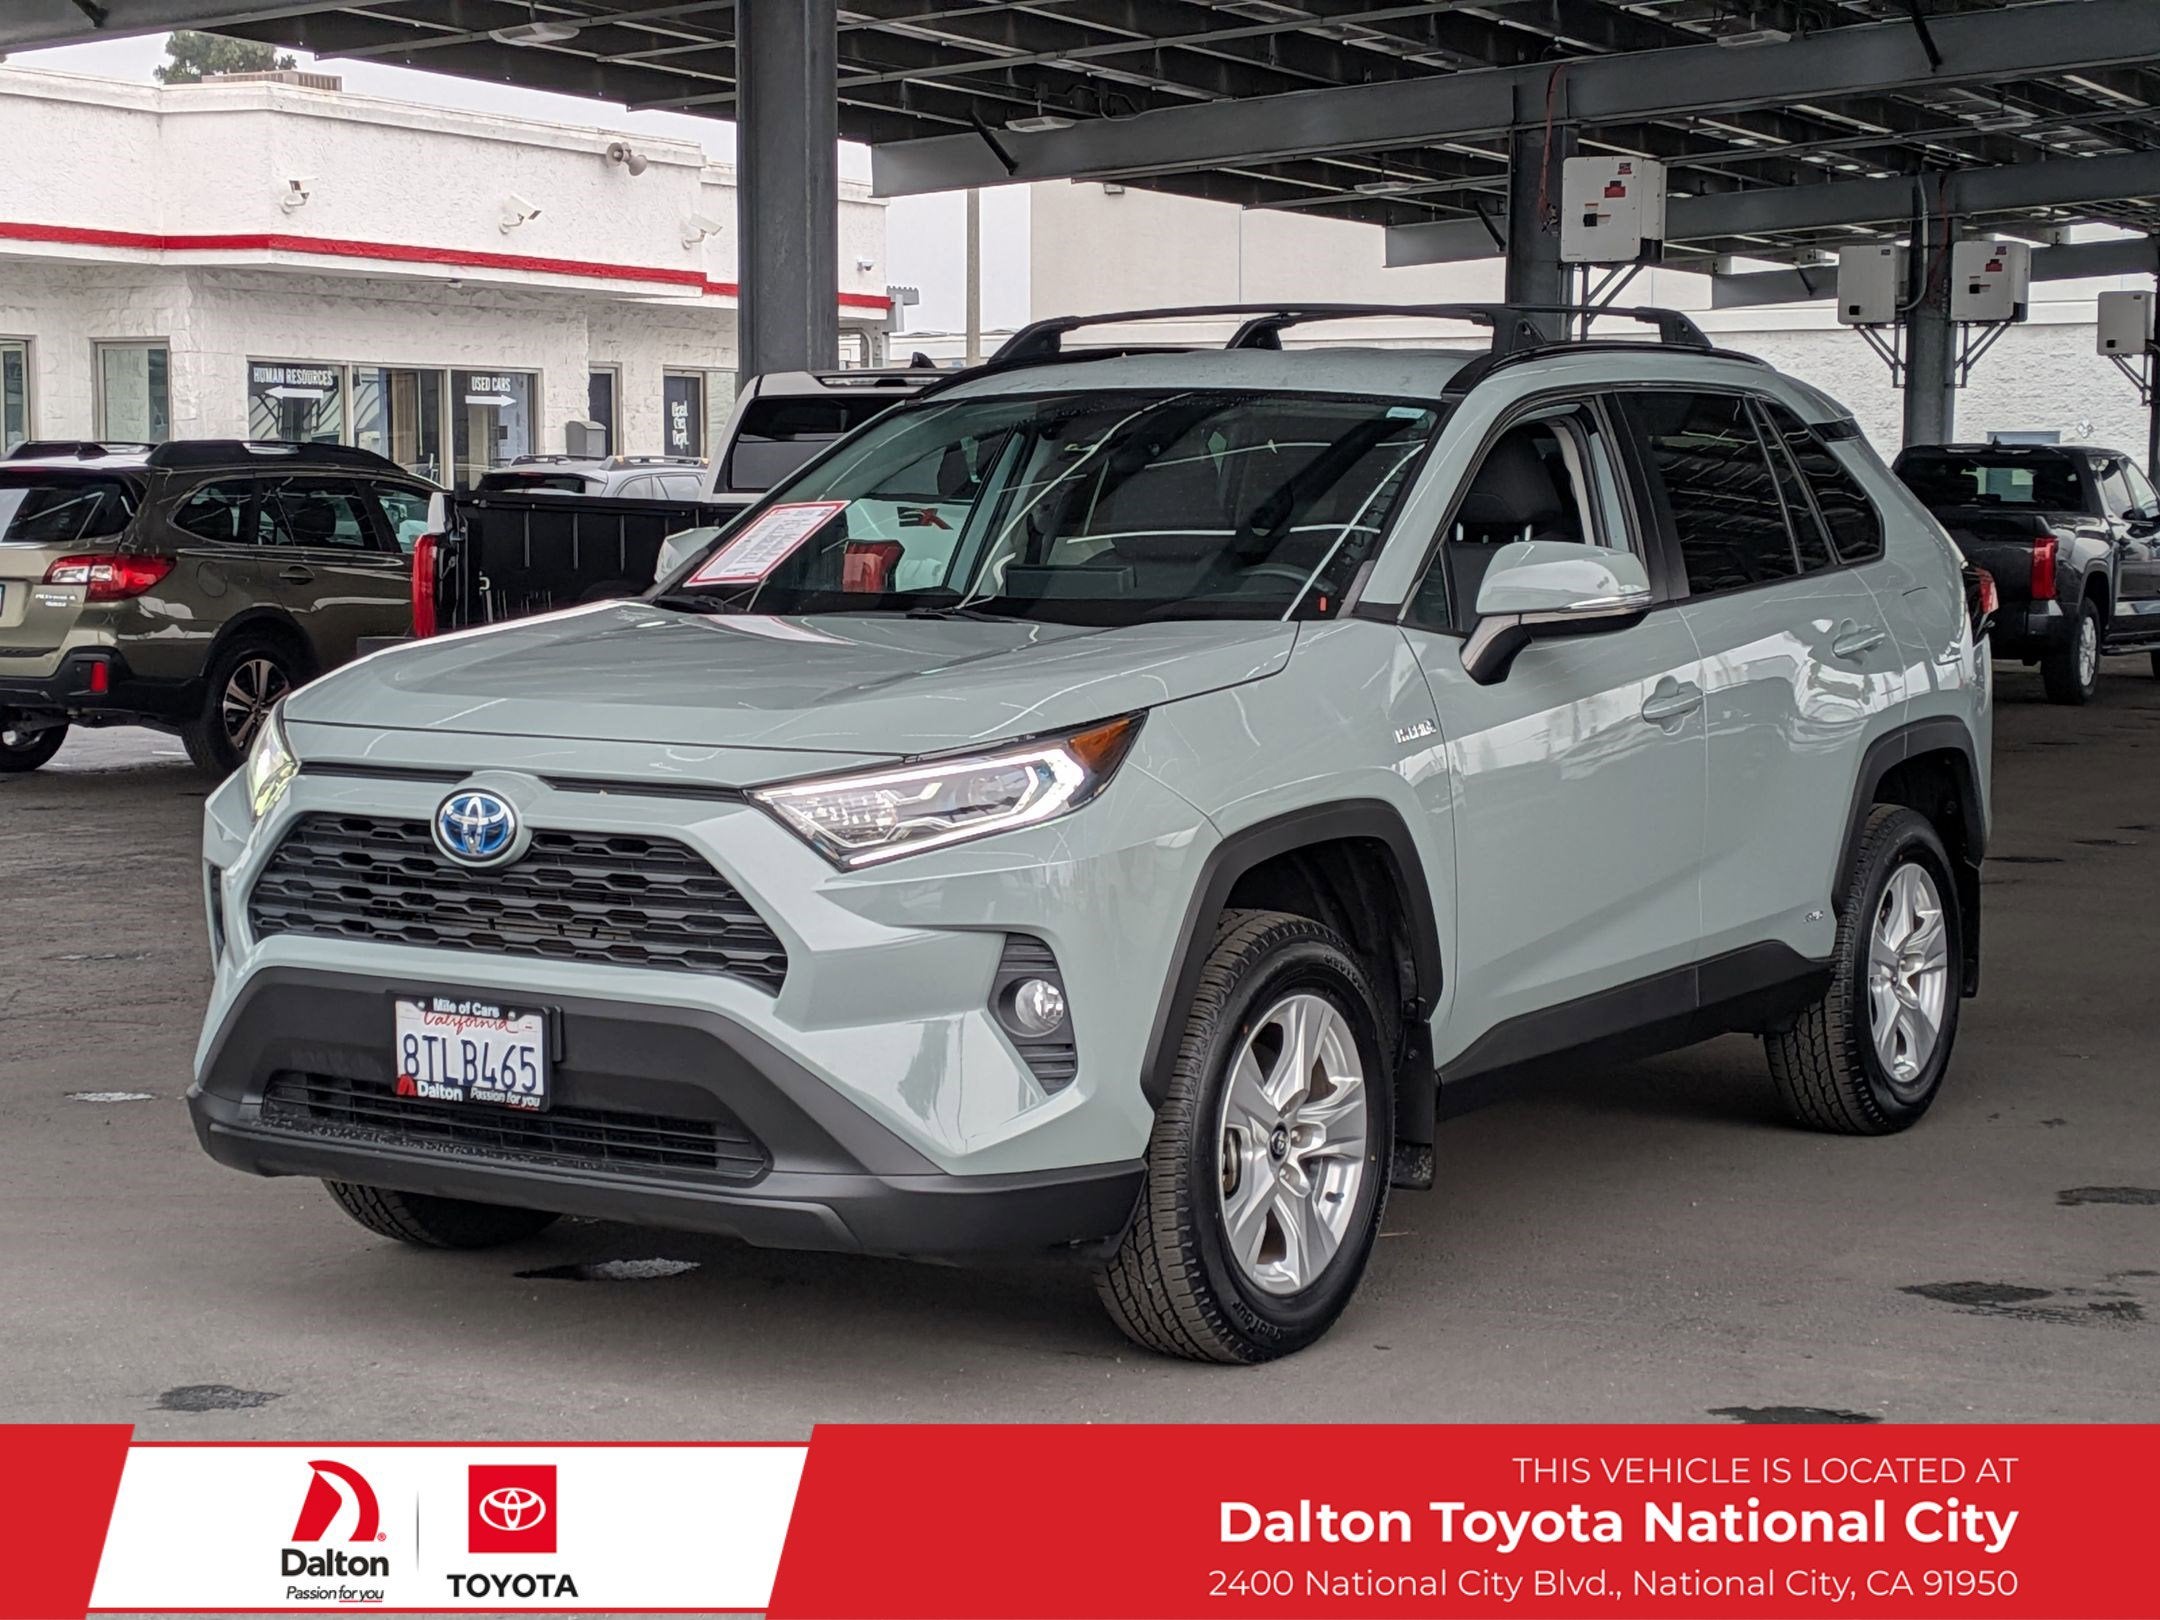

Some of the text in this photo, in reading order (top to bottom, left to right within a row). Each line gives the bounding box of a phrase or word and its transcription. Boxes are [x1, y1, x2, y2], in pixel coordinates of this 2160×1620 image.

[253, 367, 334, 386] HUMAN RESOURCES
[471, 375, 511, 392] USED CARS
[433, 997, 500, 1018] Mile of Cars
[424, 1010, 519, 1035] California
[403, 1033, 537, 1093] 8TLB465
[416, 1080, 541, 1108] Dalton Passion for you
